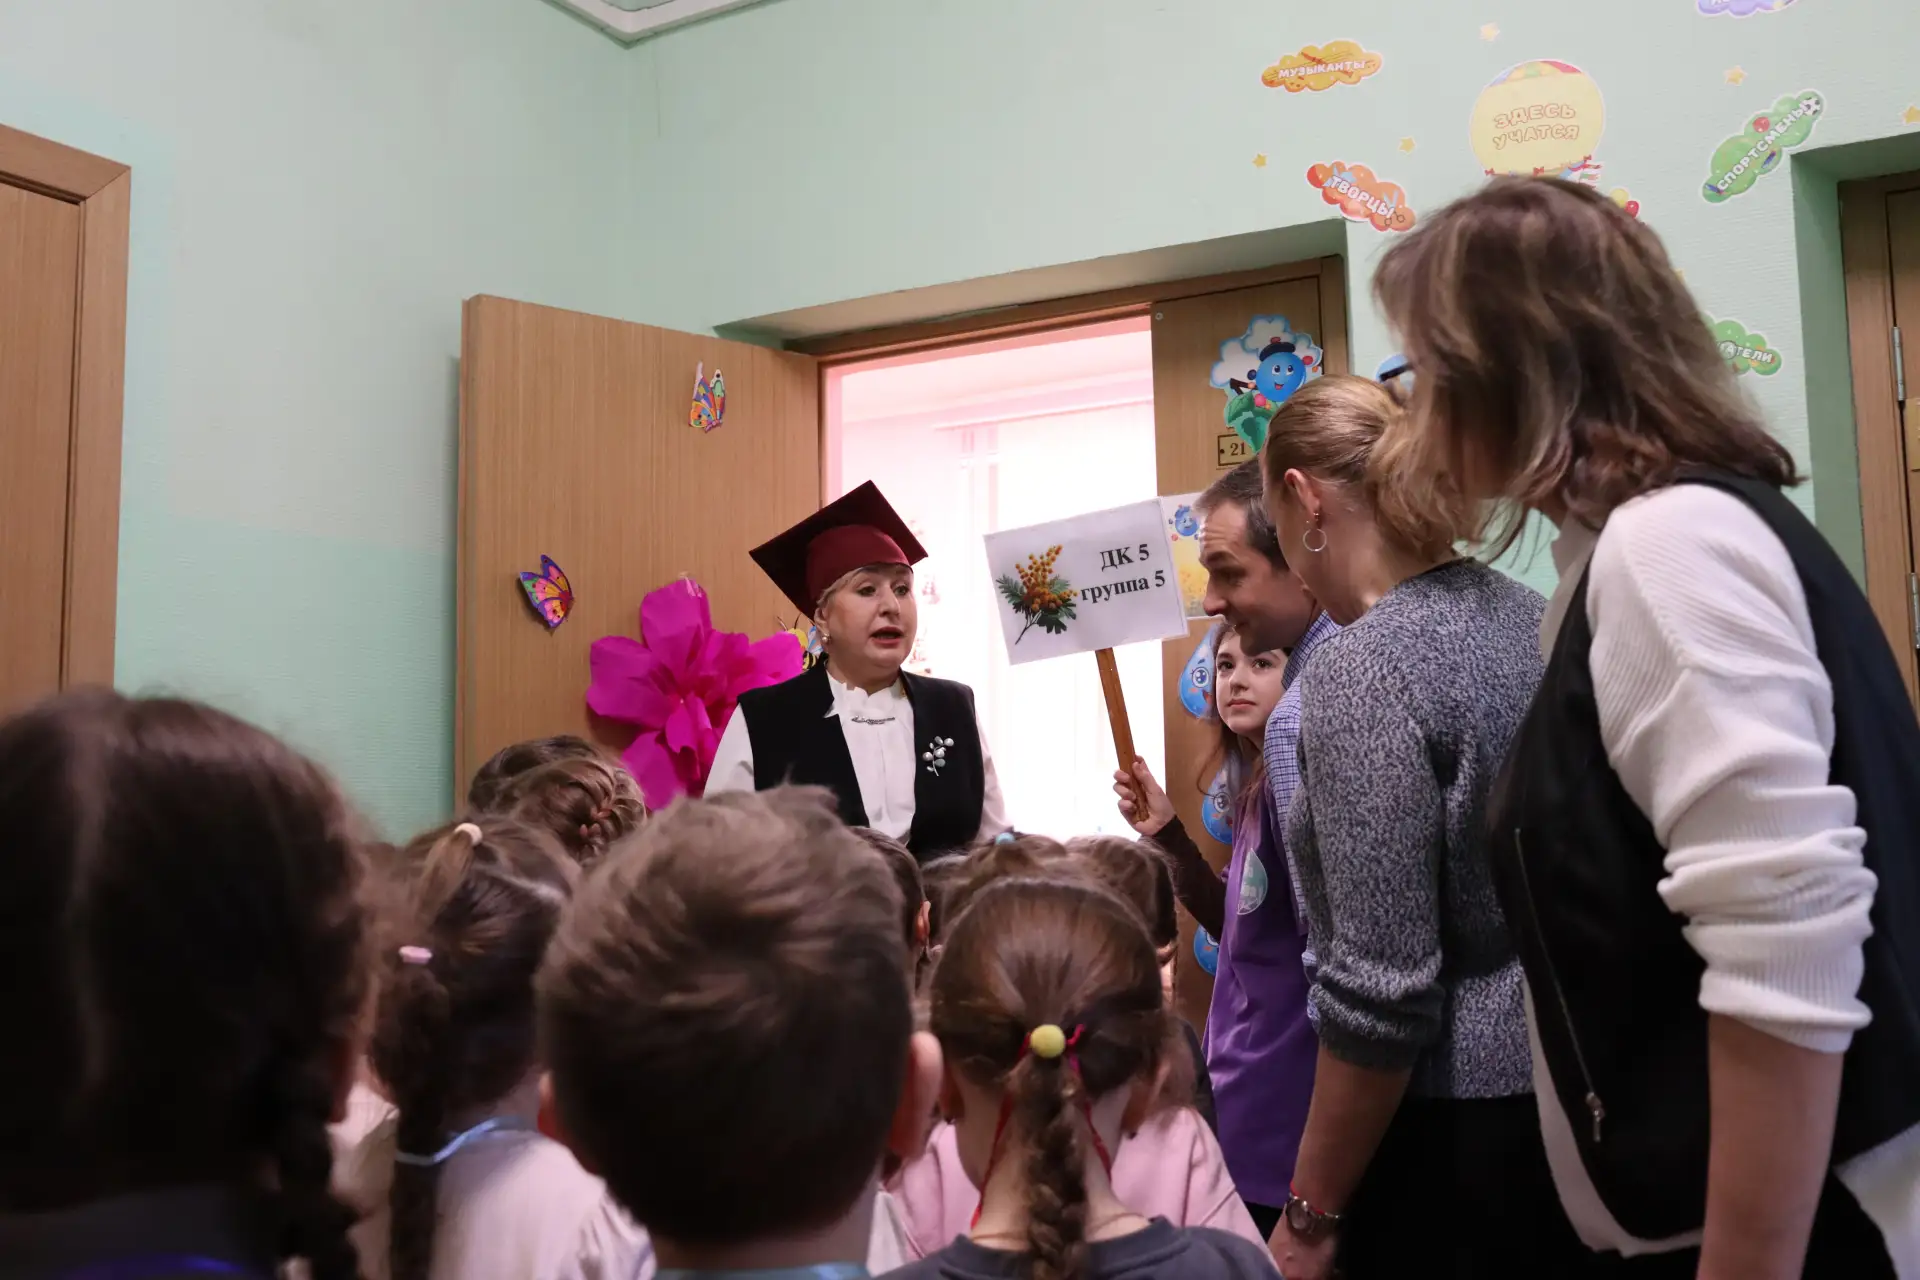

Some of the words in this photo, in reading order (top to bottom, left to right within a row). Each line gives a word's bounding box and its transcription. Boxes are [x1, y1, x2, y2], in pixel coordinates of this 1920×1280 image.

[1278, 60, 1366, 78] МУЗЫКАНТЫ
[1493, 103, 1575, 129] ЗДЕСЬ
[1493, 125, 1579, 150] УЧАТСЯ
[1717, 99, 1810, 190] СПОРТСМЕНЫ
[1330, 176, 1395, 218] ТВОРЦЫ
[1230, 442, 1245, 456] 21
[1099, 546, 1134, 572] ДК
[1139, 544, 1149, 561] 5
[1080, 578, 1149, 604] группа
[1155, 570, 1165, 587] 5
